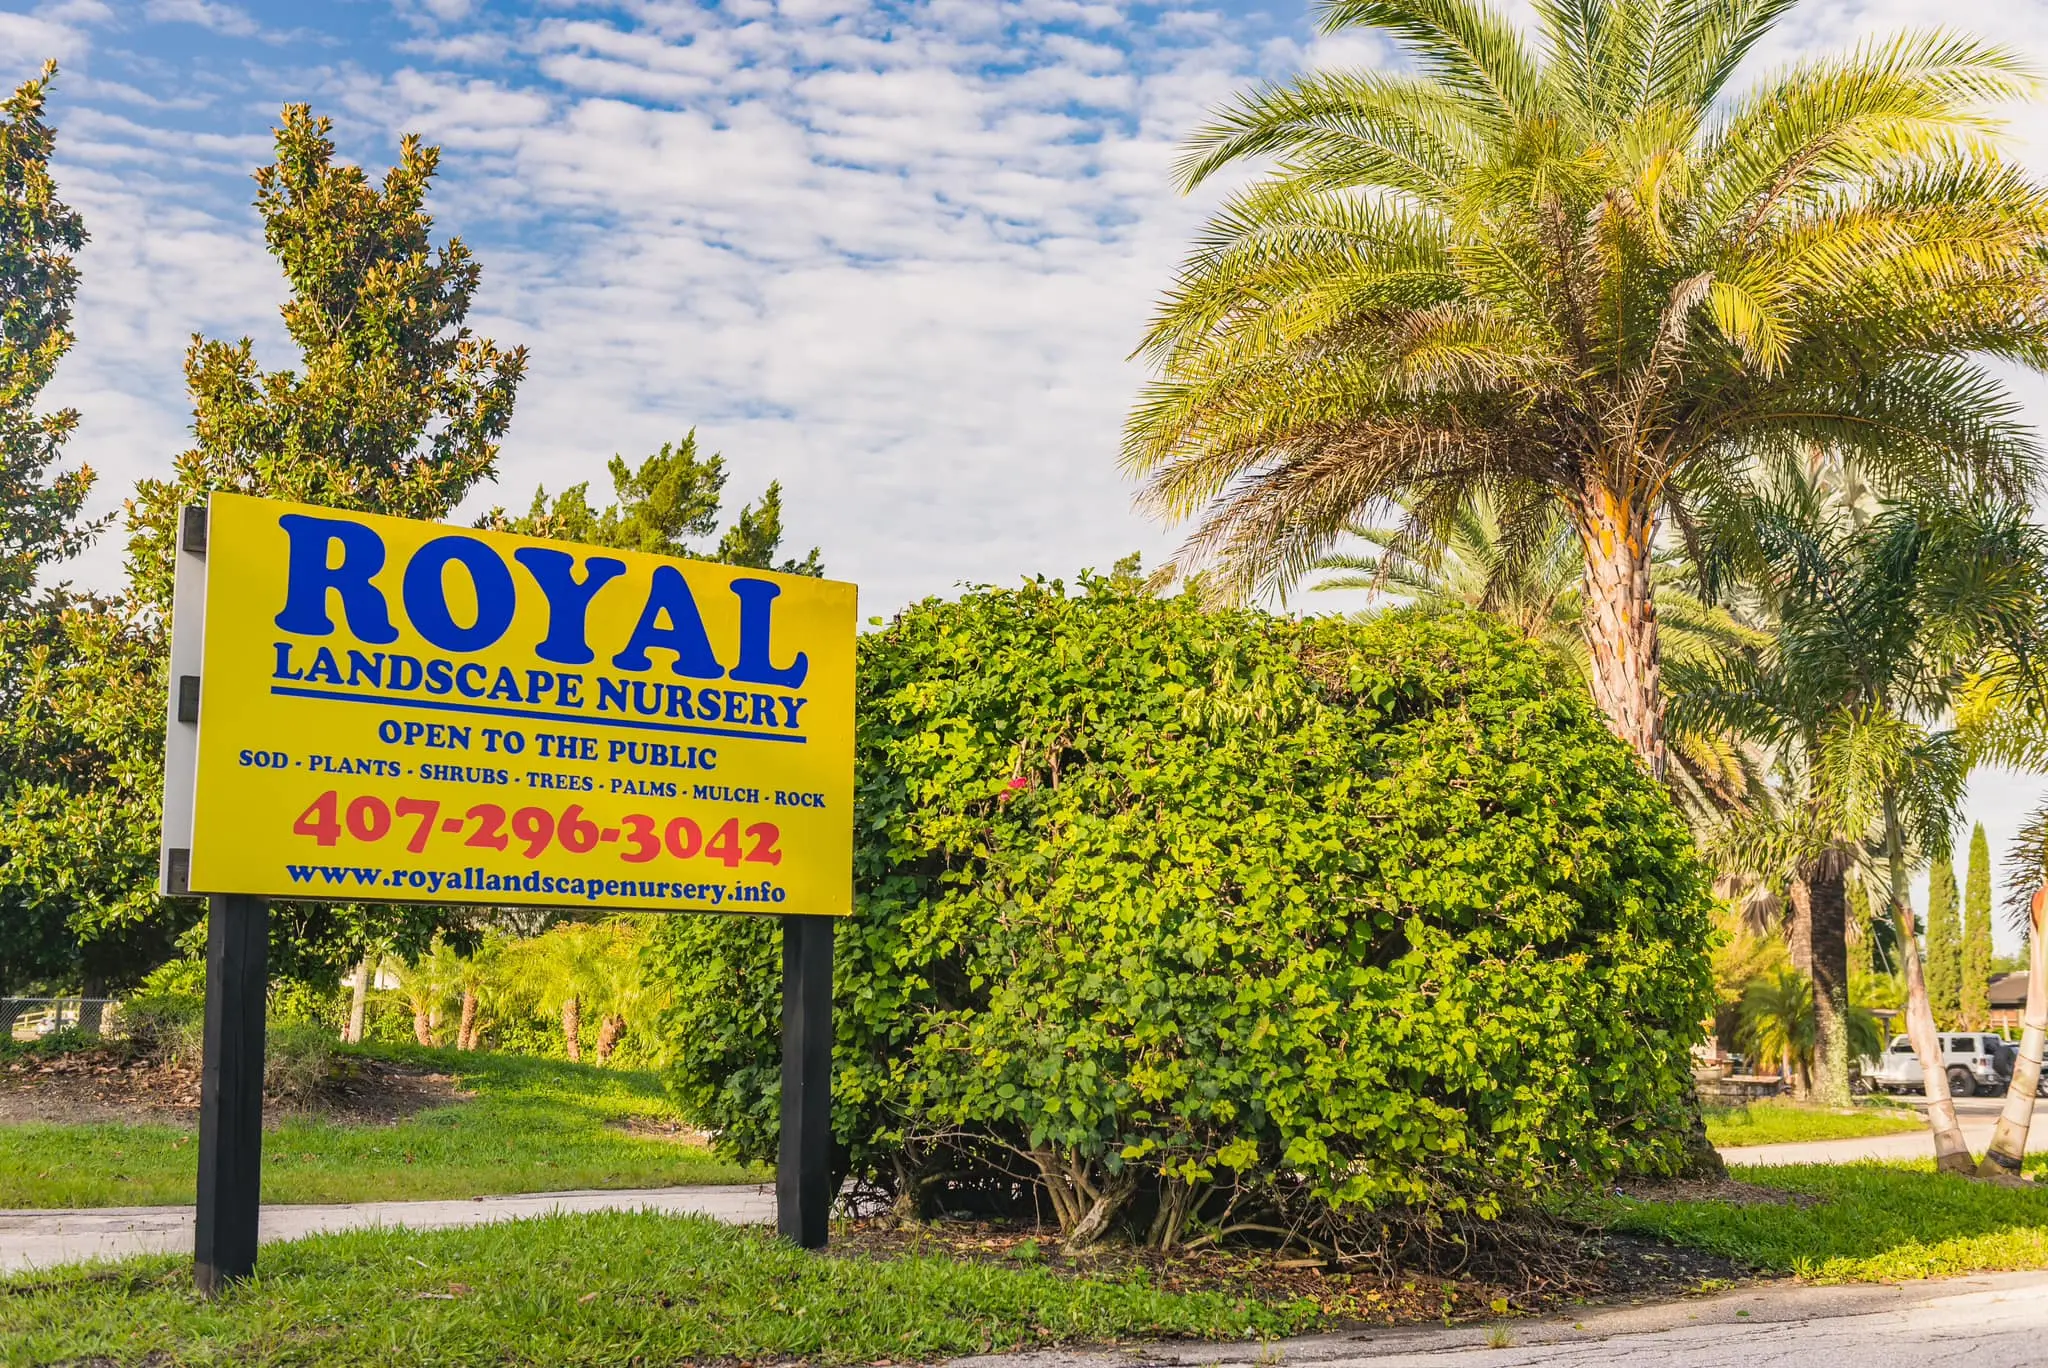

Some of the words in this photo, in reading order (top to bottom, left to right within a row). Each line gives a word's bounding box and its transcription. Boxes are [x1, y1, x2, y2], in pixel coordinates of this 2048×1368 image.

[273, 513, 809, 690] ROYAL
[271, 641, 585, 709] LANDSCAPE
[595, 676, 809, 729] NURSERY
[238, 749, 289, 769] SOD
[308, 754, 401, 778] PLANTS
[419, 763, 509, 786] SHRUBS
[525, 771, 594, 792] TREES
[610, 778, 677, 798] PALMS
[692, 784, 760, 804] MULCH
[774, 790, 827, 809] ROCK
[378, 719, 472, 751] OPEN
[480, 727, 526, 755] TO
[534, 732, 599, 761] THE
[607, 739, 717, 771] PUBLIC
[292, 789, 783, 870] 407-296-3042
[285, 864, 787, 905] www.royallandscapenursery.info
